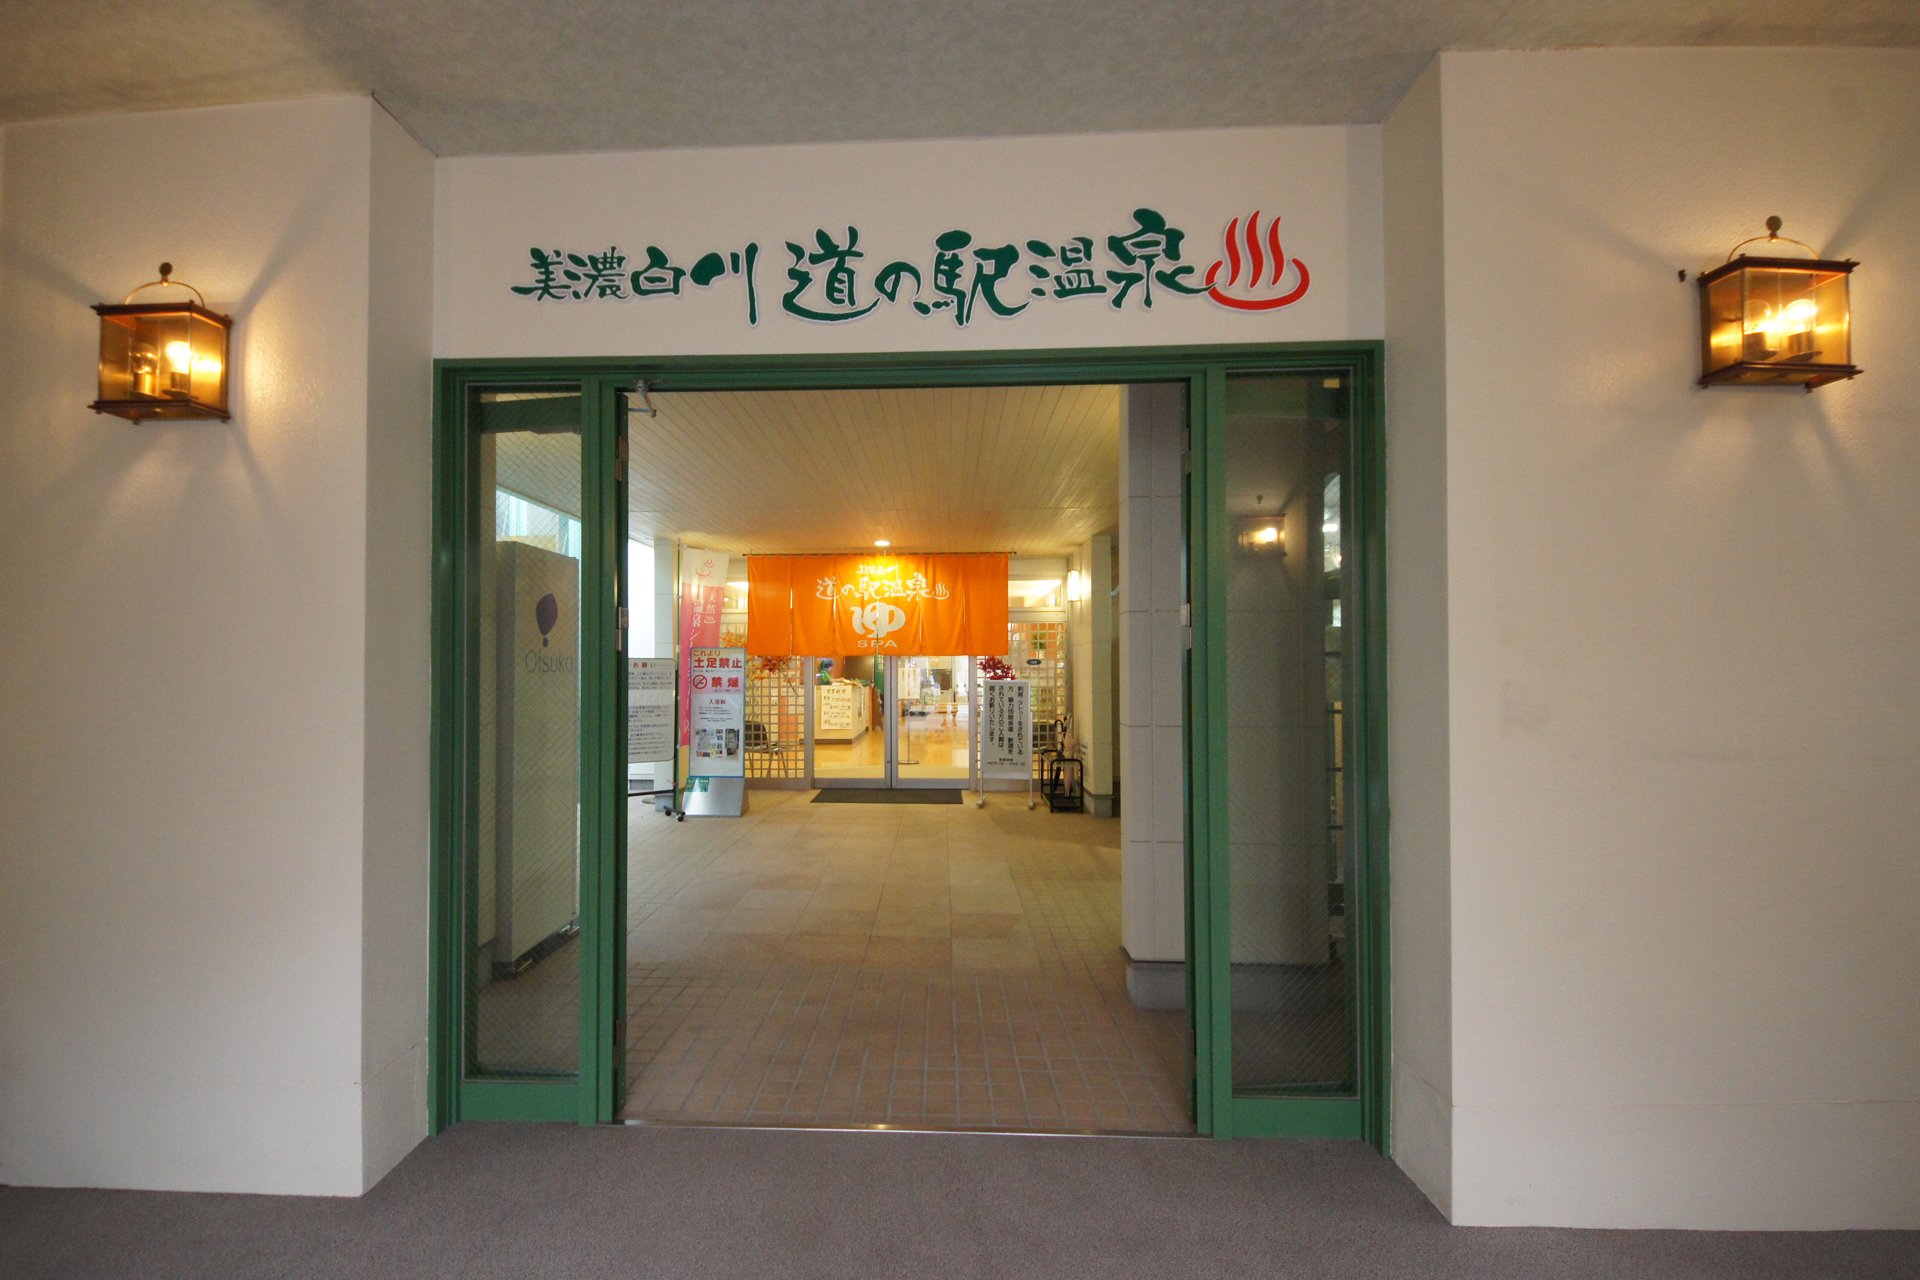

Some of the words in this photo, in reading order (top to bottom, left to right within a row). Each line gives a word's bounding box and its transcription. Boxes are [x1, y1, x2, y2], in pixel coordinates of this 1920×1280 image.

[511, 243, 759, 326] 美濃白川
[782, 208, 1218, 327] 道の駅温泉
[857, 640, 898, 648] SPA
[525, 650, 574, 673] Otsuka
[693, 657, 742, 668] 土足禁止
[711, 677, 739, 687] 禁煙
